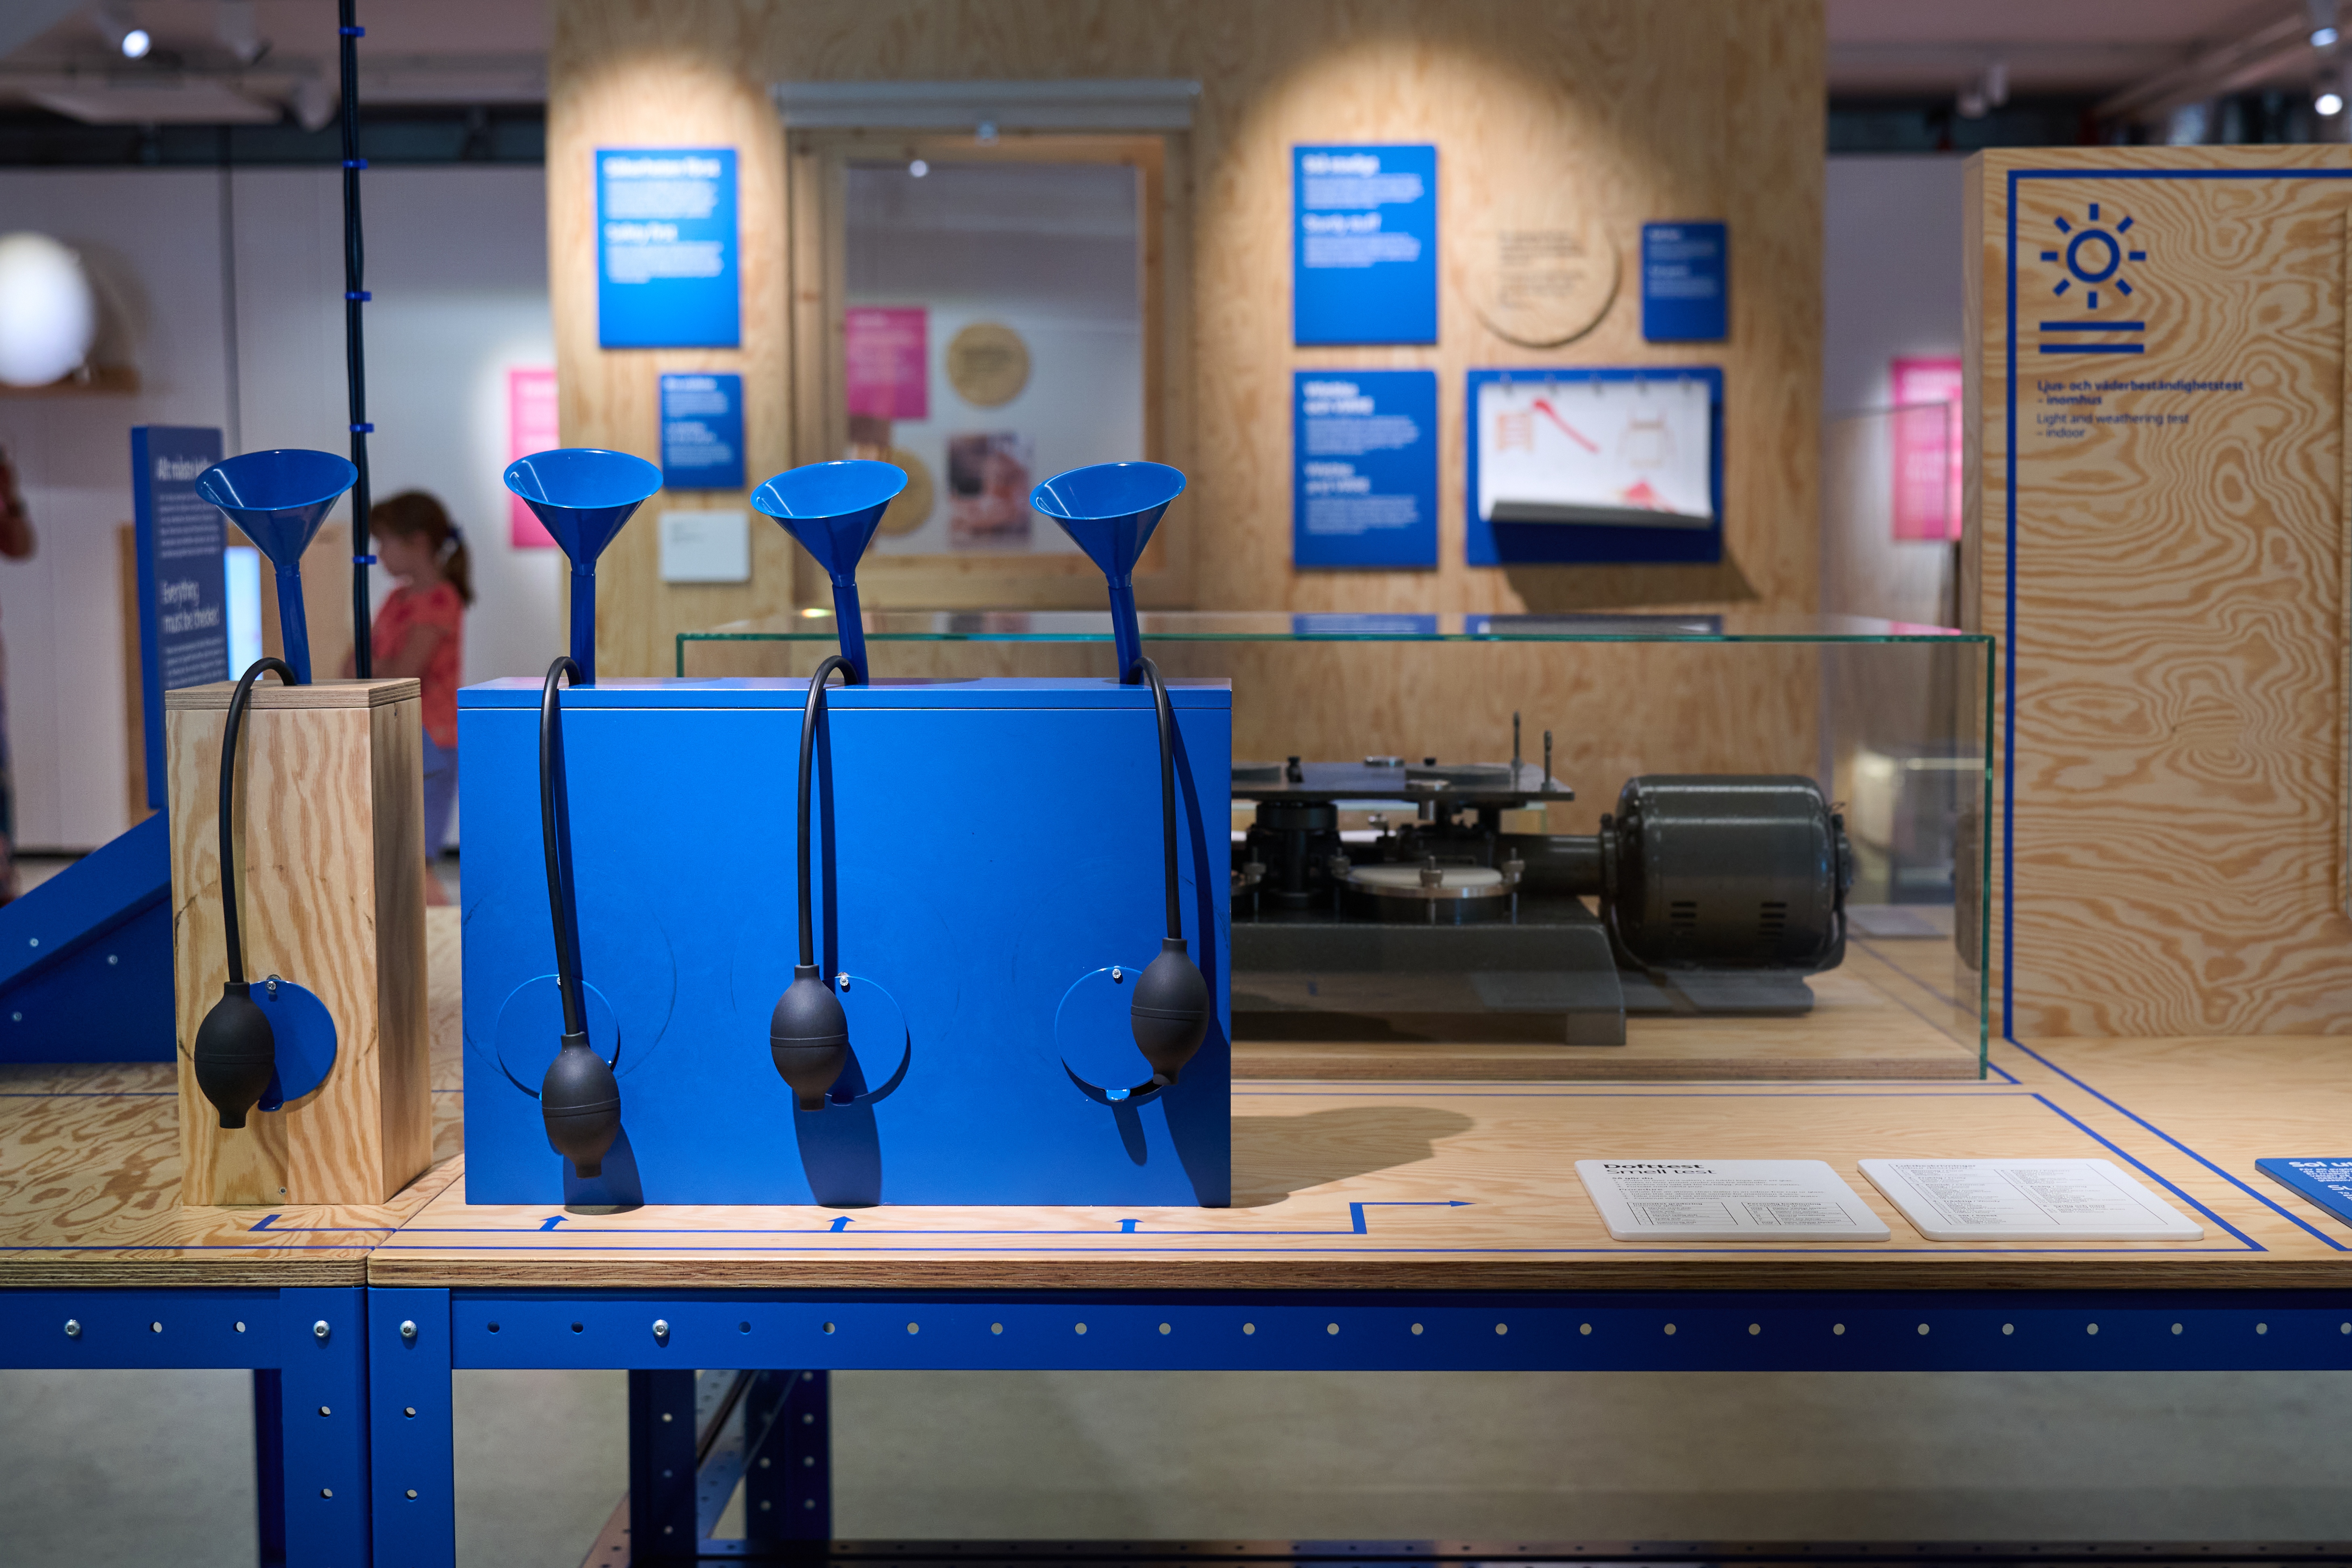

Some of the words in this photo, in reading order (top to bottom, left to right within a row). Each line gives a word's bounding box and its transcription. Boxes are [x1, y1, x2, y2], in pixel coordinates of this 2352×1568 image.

[2037, 380, 2066, 394] Ljus-
[2069, 380, 2092, 391] och
[2095, 379, 2244, 394] väderbeständighetstest
[2046, 395, 2102, 405] inomhus
[2036, 413, 2066, 425] Light
[2071, 413, 2092, 424] and
[2096, 413, 2163, 426] weathering
[2167, 414, 2189, 424] test
[2046, 428, 2085, 438] indoor
